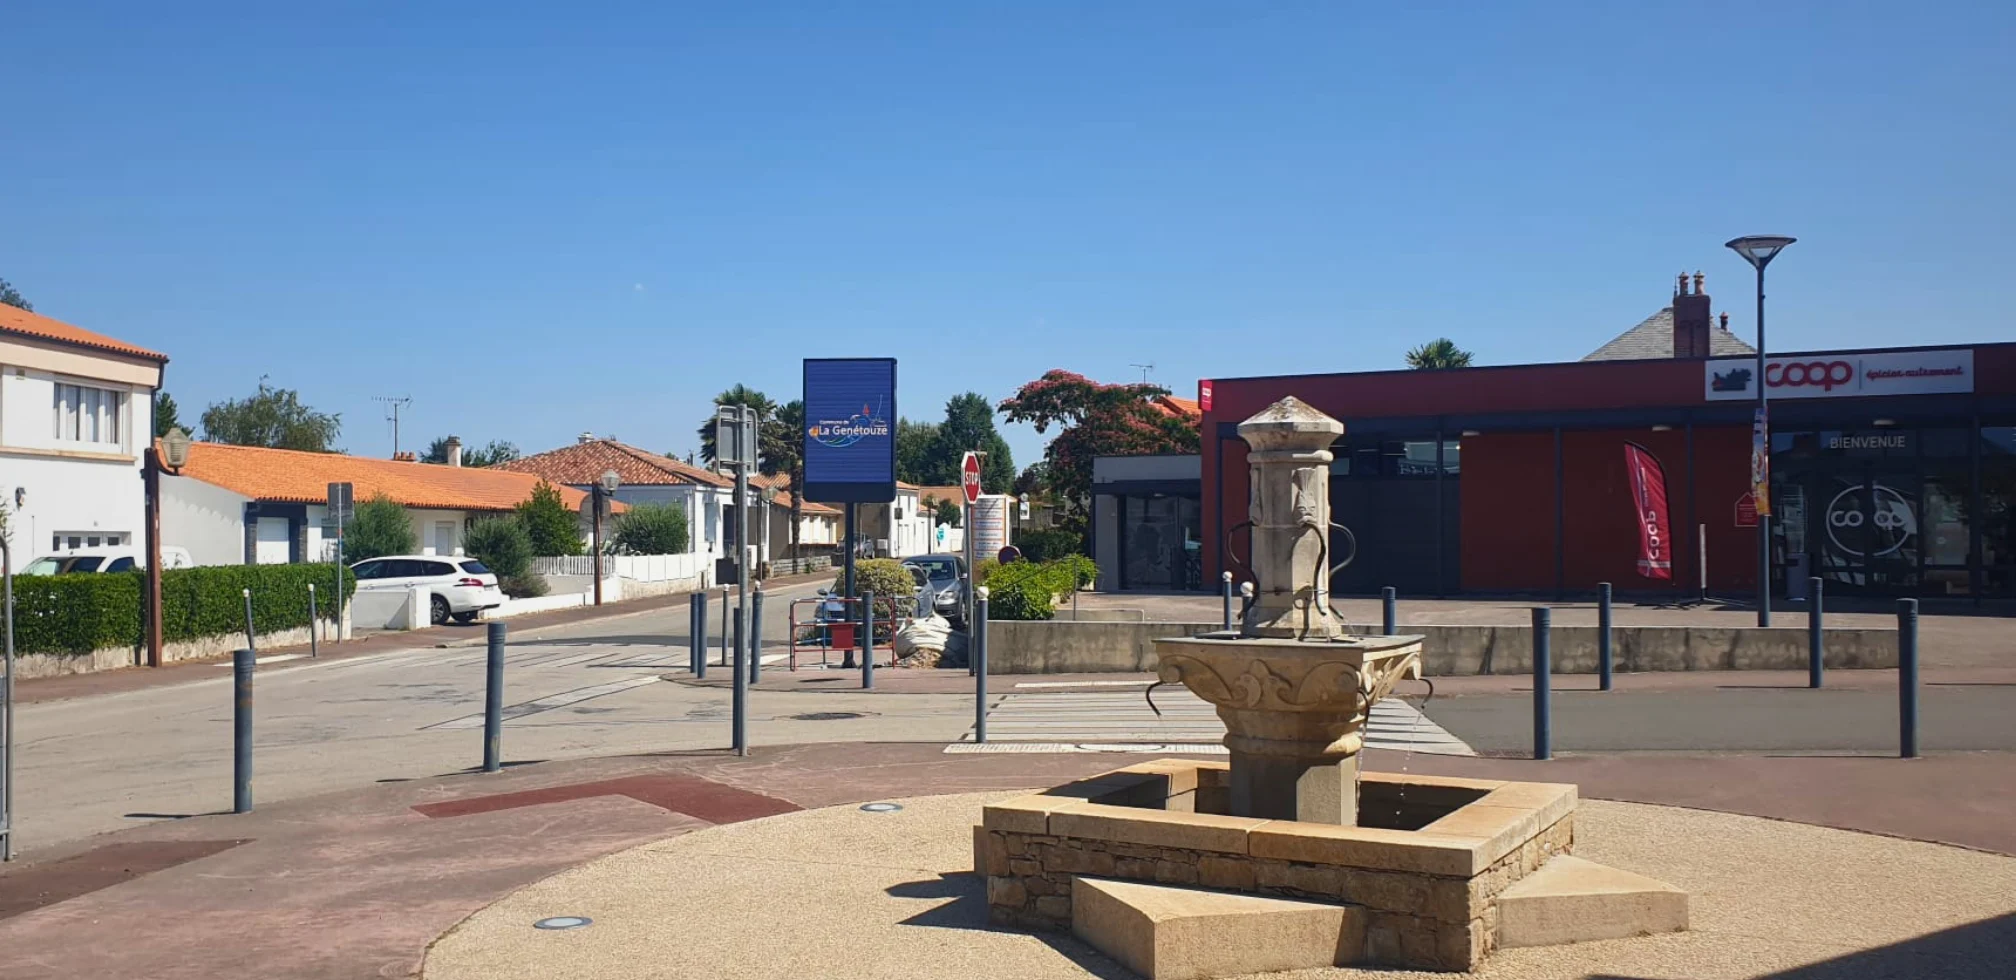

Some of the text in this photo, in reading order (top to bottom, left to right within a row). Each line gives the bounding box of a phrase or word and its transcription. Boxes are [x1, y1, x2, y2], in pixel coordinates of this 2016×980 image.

[819, 425, 888, 436] La Genétouze
[1830, 436, 1905, 449] BIENVENUE
[965, 471, 979, 485] STOP
